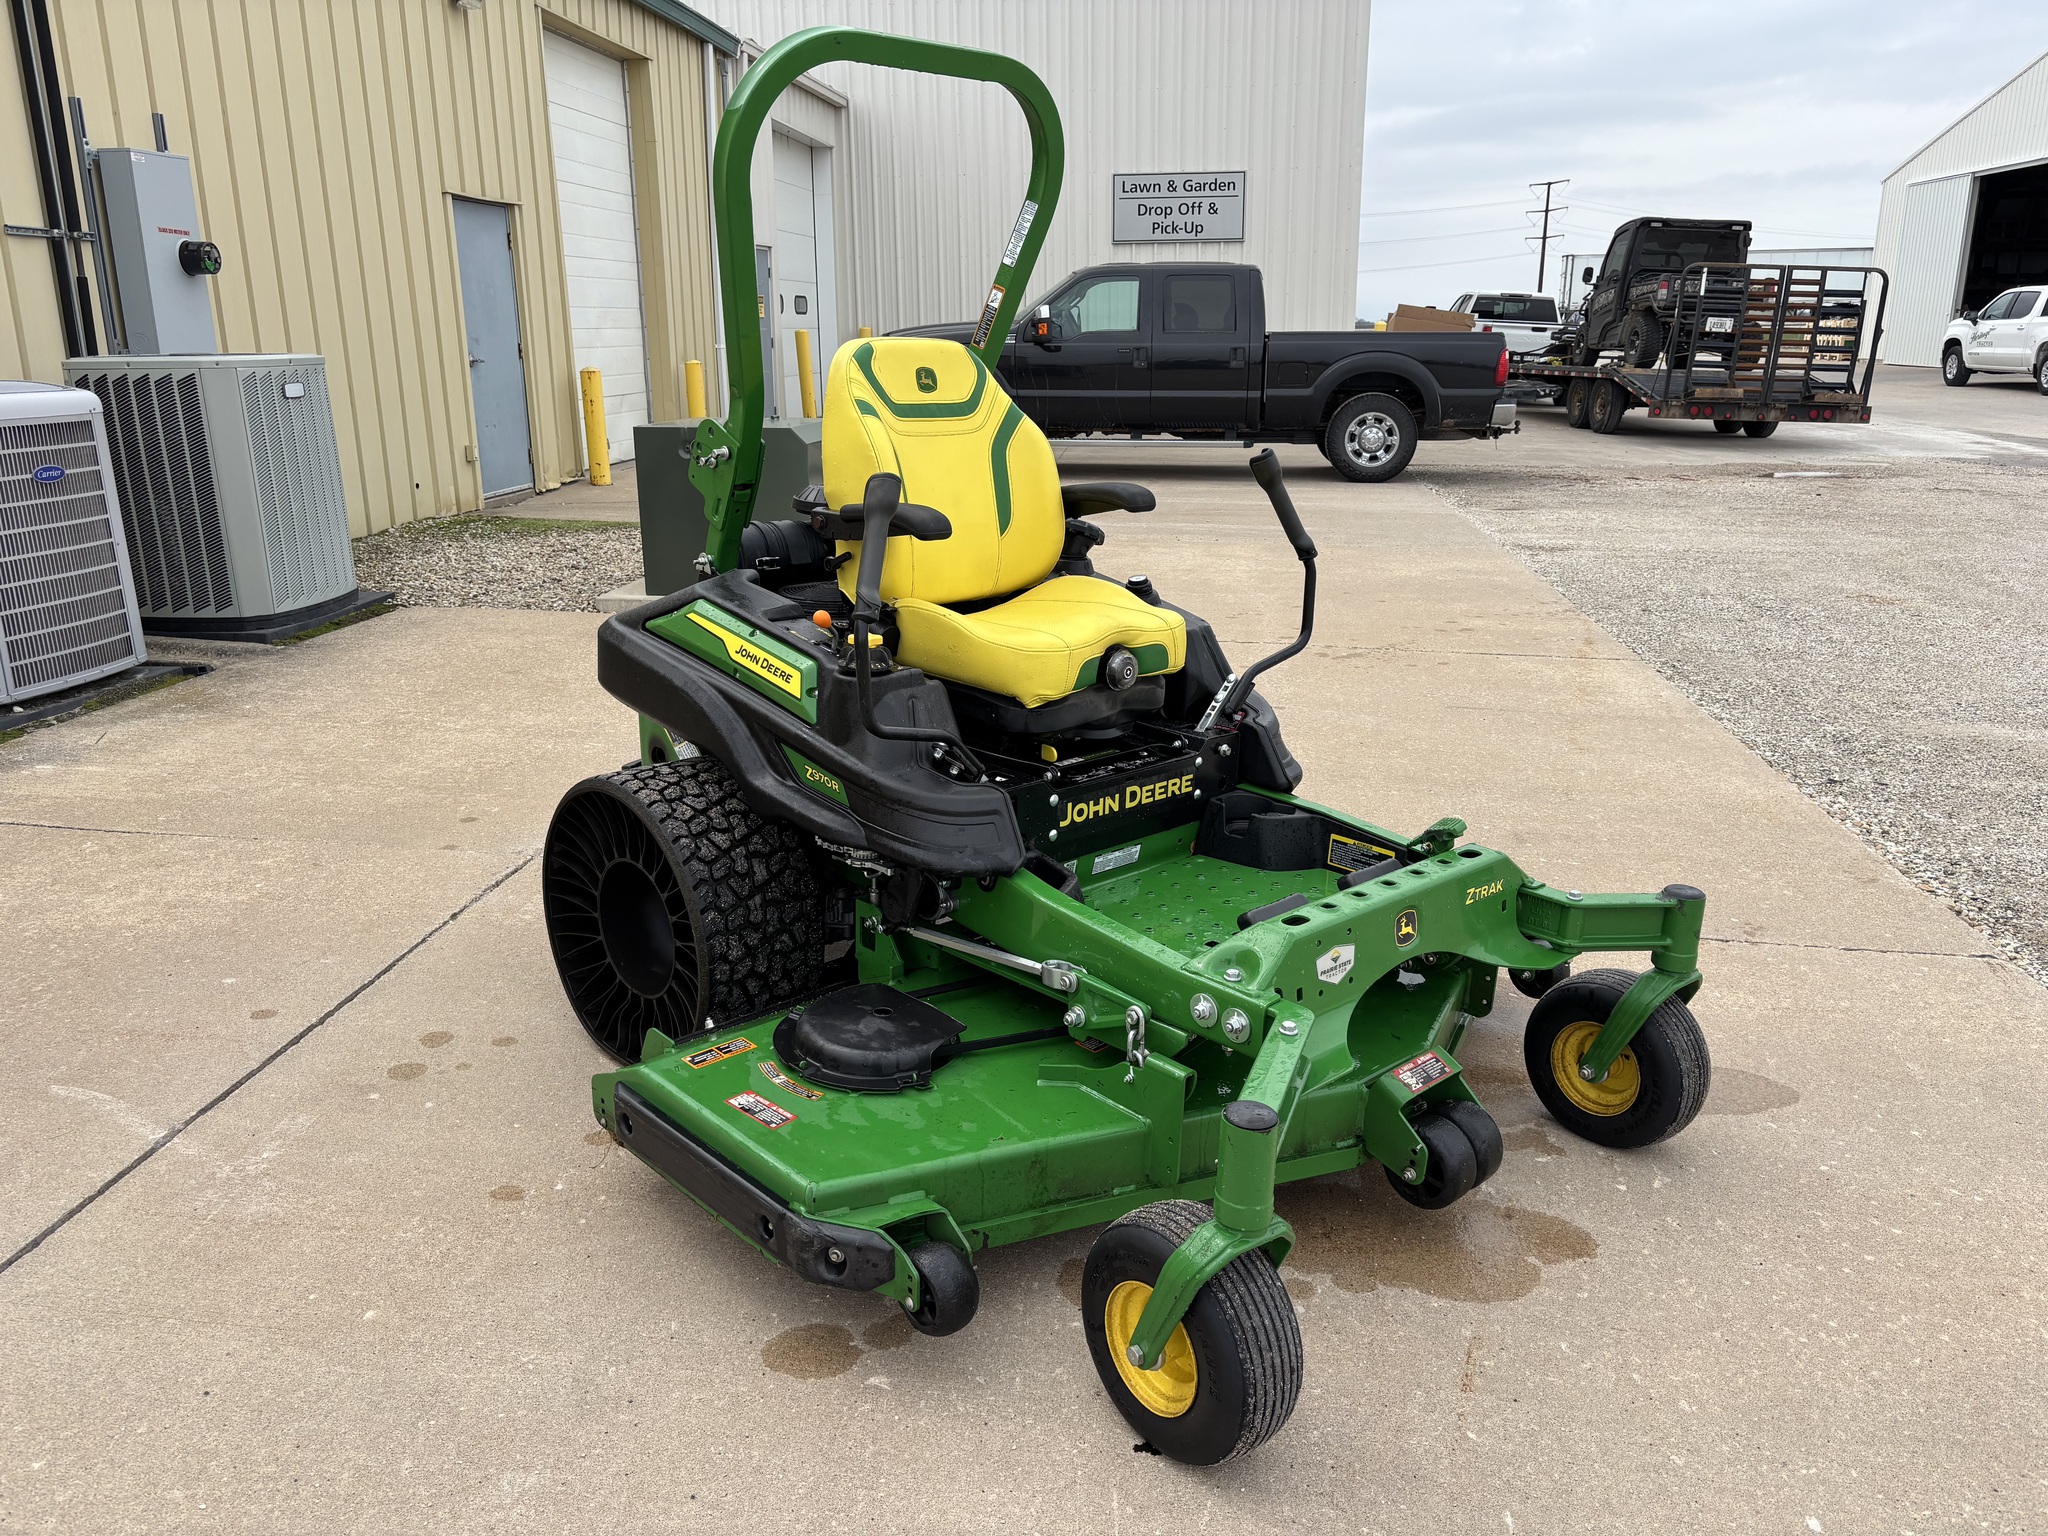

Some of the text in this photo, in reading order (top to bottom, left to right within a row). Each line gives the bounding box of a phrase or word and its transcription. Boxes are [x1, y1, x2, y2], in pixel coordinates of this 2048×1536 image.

[1122, 178, 1236, 193] Lawn & Garden
[1137, 201, 1219, 219] Drop Off &
[1152, 220, 1204, 237] Pick-Up
[37, 469, 62, 478] Carrier
[735, 644, 793, 684] JOHN DEERE
[804, 764, 840, 792] Z970R
[1059, 774, 1194, 828] JOHN DEERE
[1465, 878, 1504, 905] ZTRAK
[1320, 958, 1352, 976] PRAIRIE STATE
[1325, 967, 1347, 980] TRACTOR
